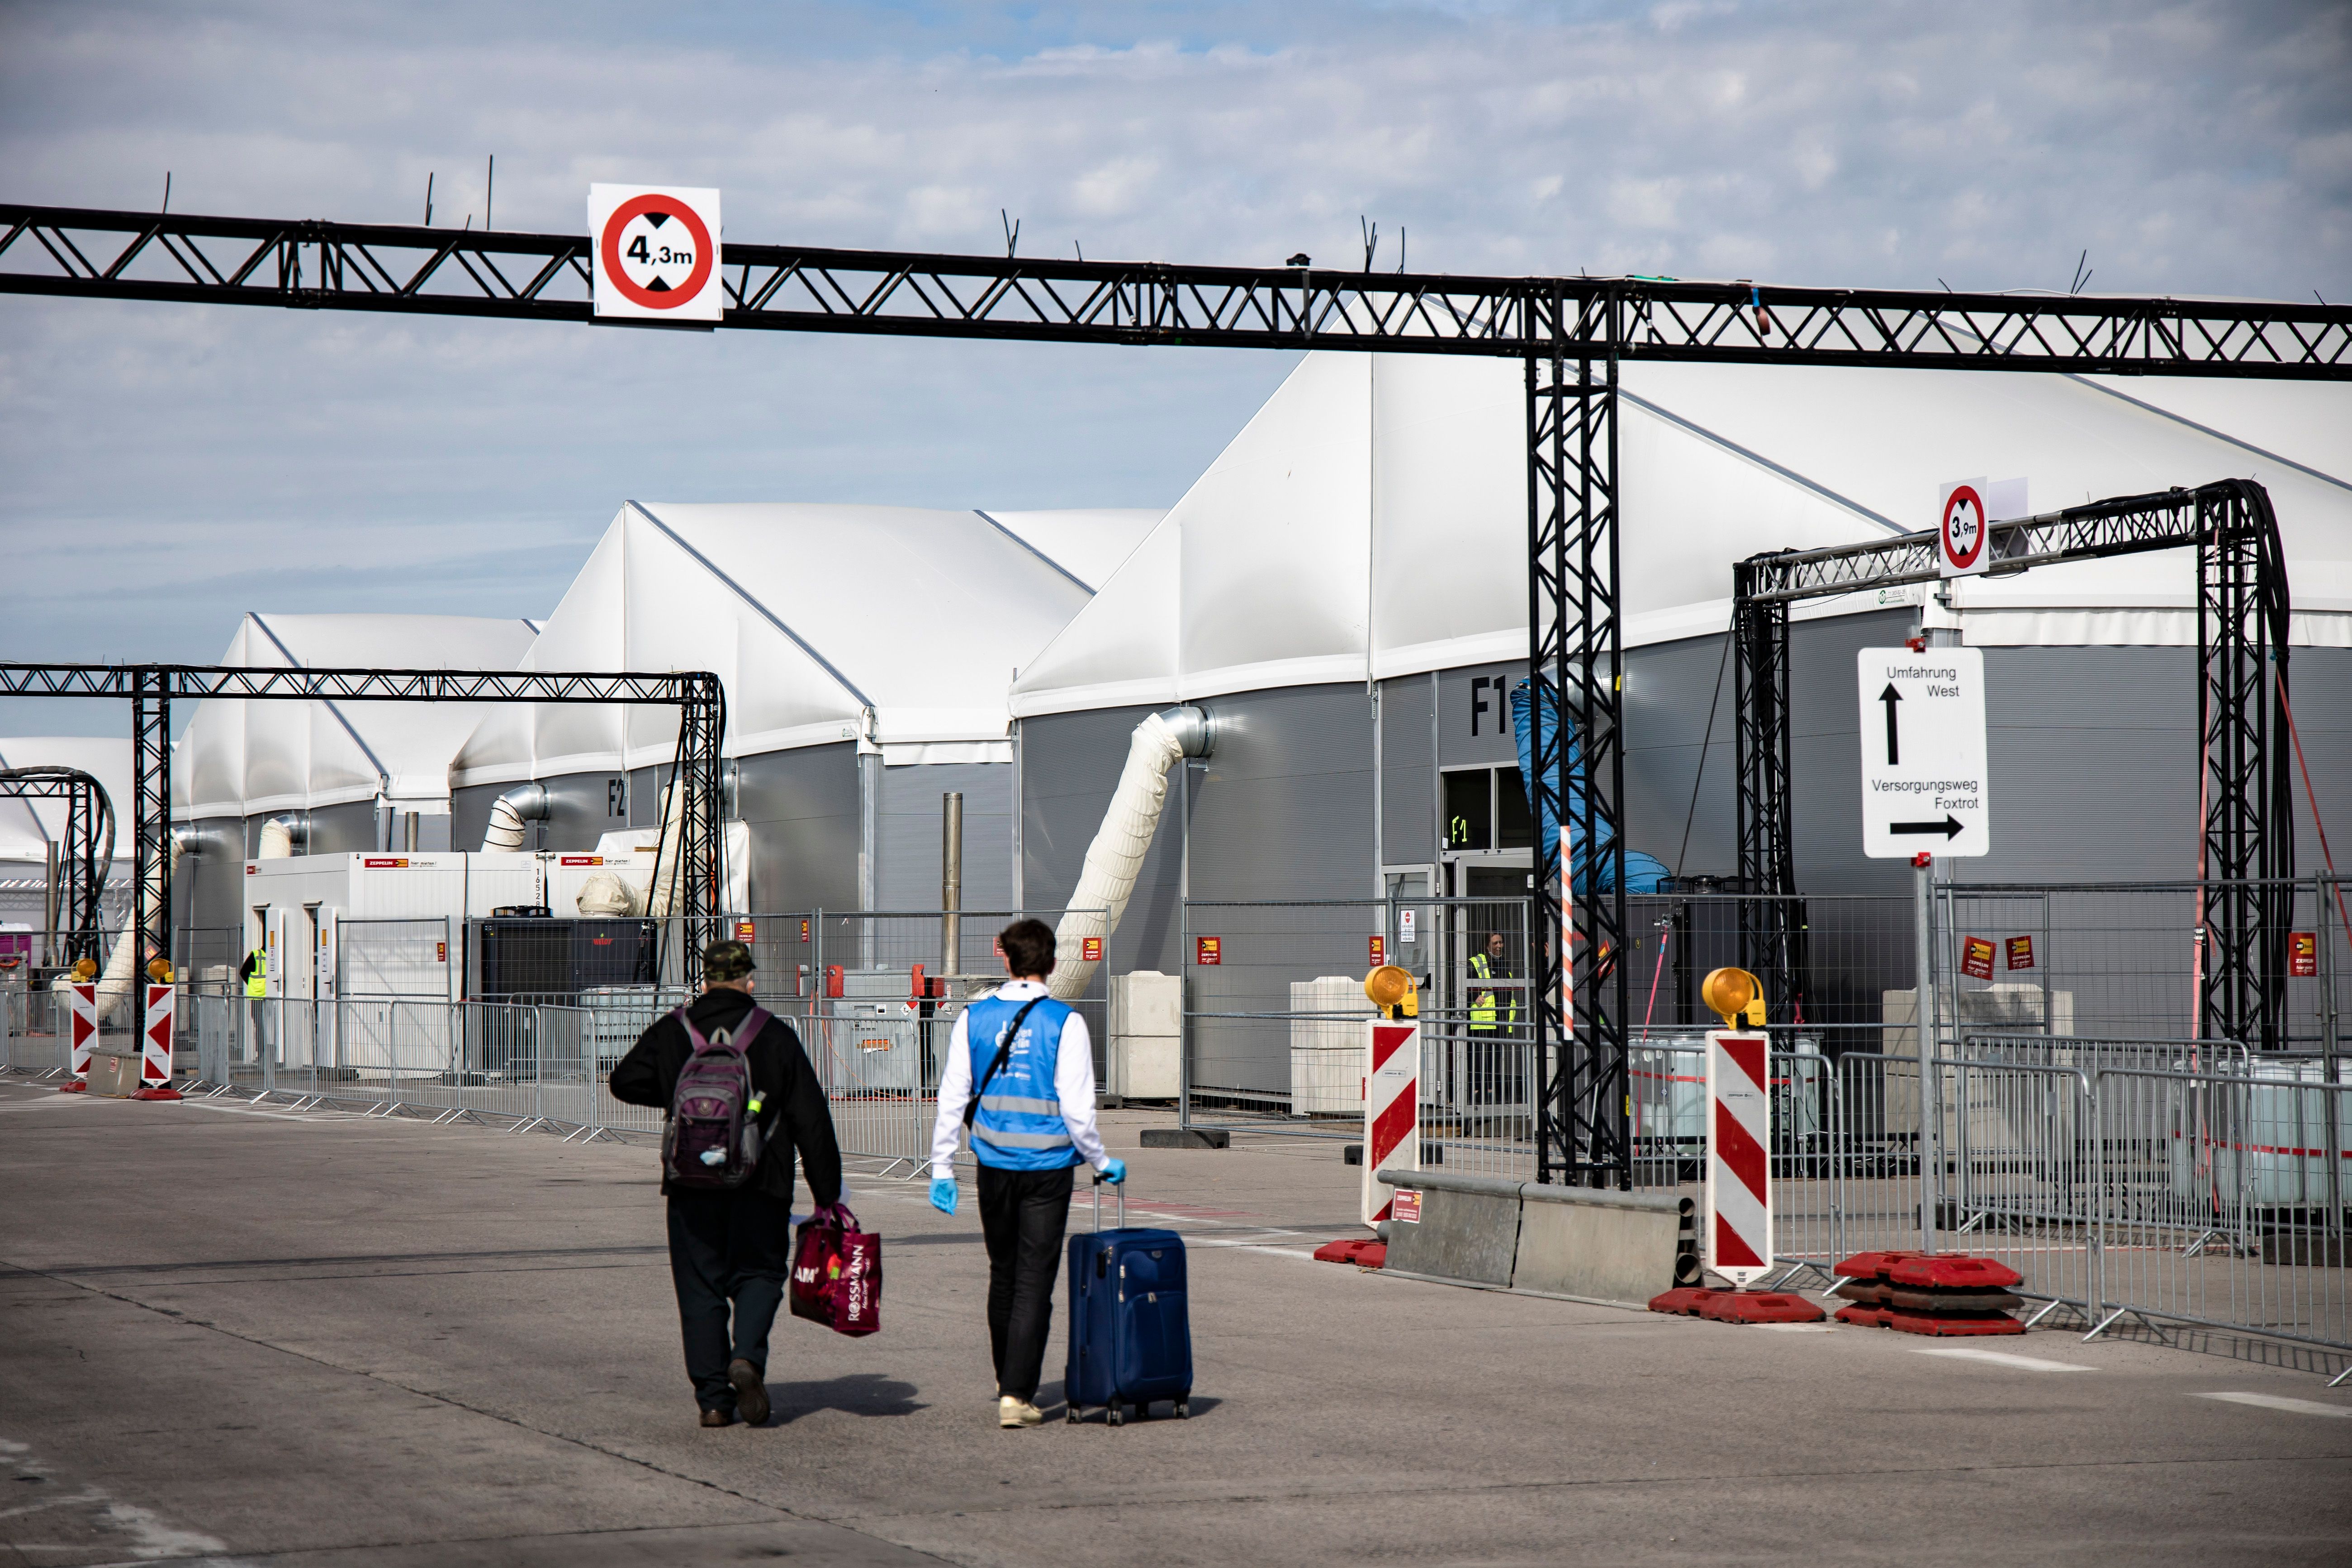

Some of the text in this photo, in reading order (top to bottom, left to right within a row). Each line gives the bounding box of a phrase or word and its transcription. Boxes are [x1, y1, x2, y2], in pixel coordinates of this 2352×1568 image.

[627, 235, 692, 266] 4,3m
[1952, 516, 1977, 538] 3,9m
[1887, 666, 1956, 681] Umfahrung
[1927, 685, 1960, 696] West
[1472, 674, 1506, 737] F1
[608, 778, 625, 817] F2
[1872, 779, 1978, 794] Versorgungsweg
[1935, 797, 1979, 809] Foxtrot
[1452, 815, 1467, 844] F1
[1968, 960, 1989, 968] ZEPPELIN
[848, 1245, 865, 1321] ROSSMANN
